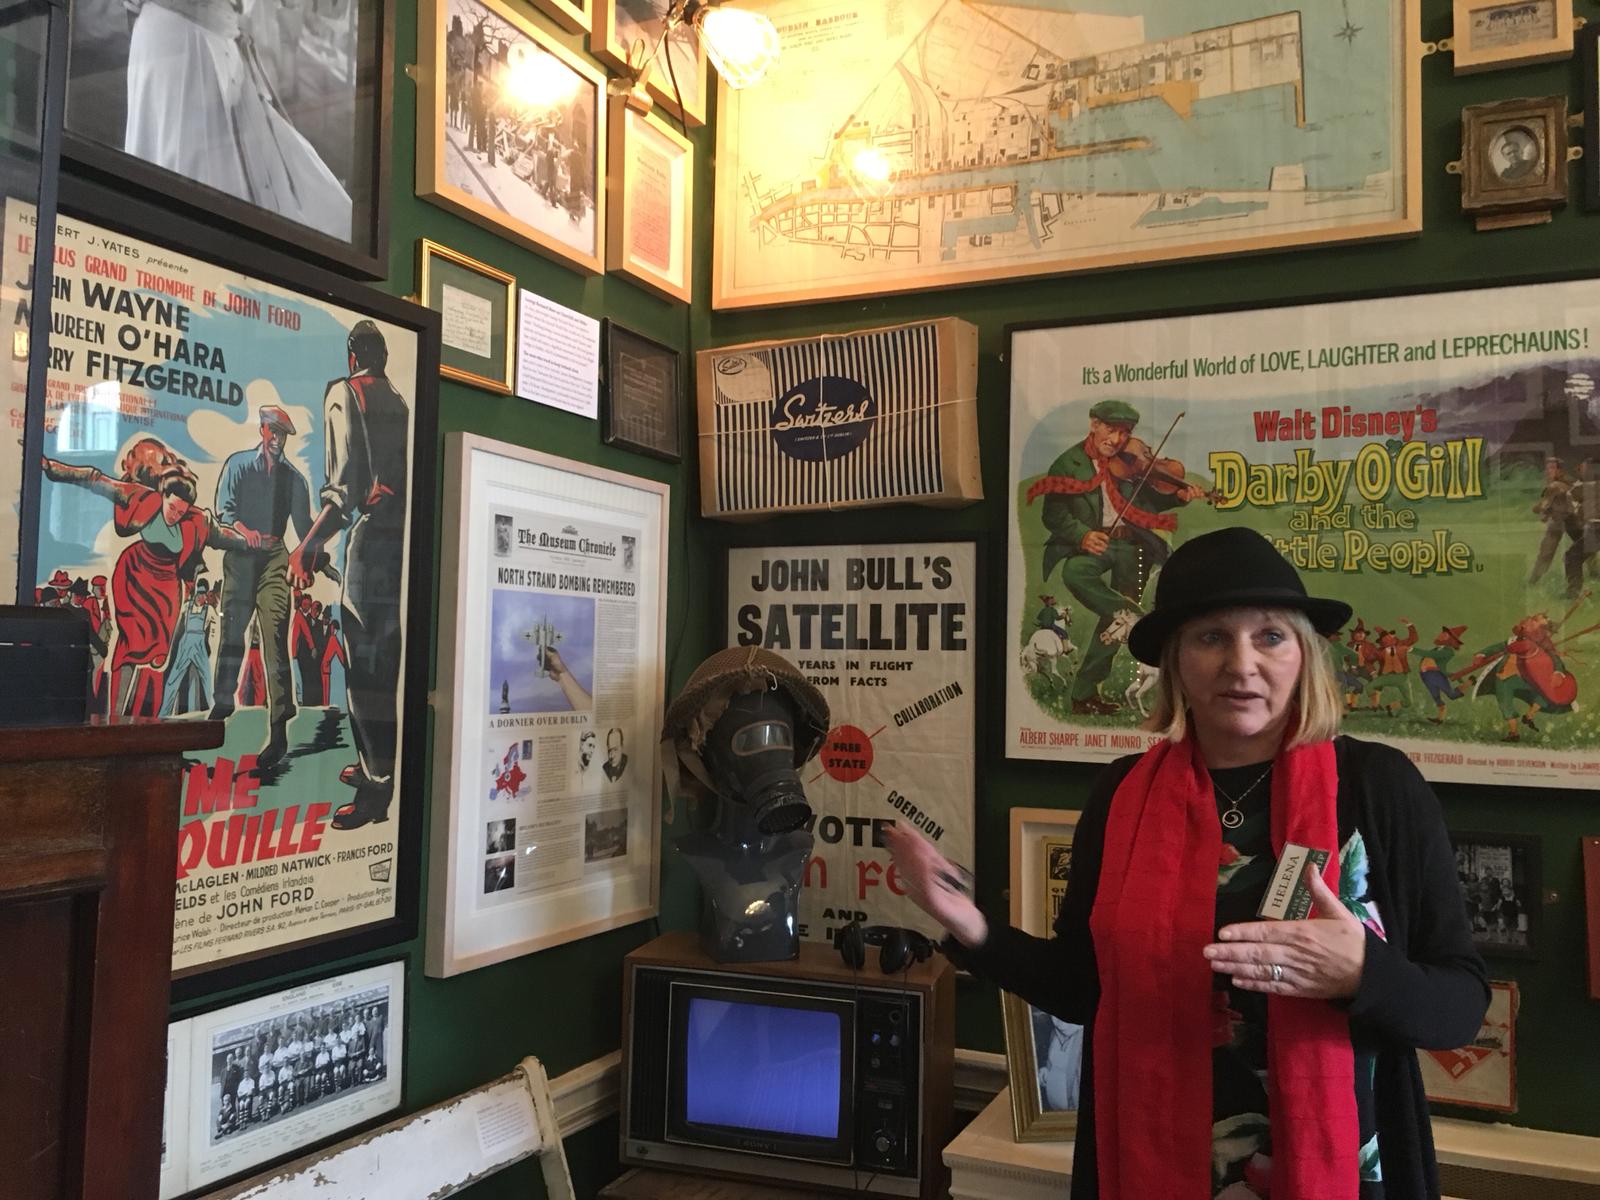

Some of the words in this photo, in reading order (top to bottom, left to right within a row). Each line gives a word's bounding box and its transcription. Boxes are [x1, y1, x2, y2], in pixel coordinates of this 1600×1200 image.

[146, 255, 189, 274] présente
[82, 278, 190, 333] WAYNE
[84, 254, 127, 283] GRAND
[136, 269, 195, 302] TRIOMPHE
[224, 292, 261, 321] JOHN
[268, 304, 302, 331] FORD
[118, 324, 226, 375] O'HARA
[1082, 366, 1100, 386] It's
[1103, 370, 1112, 384] a
[1115, 359, 1188, 384] Wonderful
[1193, 356, 1236, 378] World
[1240, 353, 1256, 374] of
[1260, 350, 1305, 374] LOVE,
[1308, 342, 1399, 369] LAUGHTER
[1404, 339, 1436, 361] and
[1442, 327, 1589, 360] LEPRECHAUNS!
[86, 349, 244, 406] FITZGERALD
[1253, 409, 1316, 442] Walt
[1322, 405, 1438, 442] Disney's
[1208, 447, 1352, 518] Darby
[1289, 503, 1352, 532] and
[1360, 503, 1416, 530] the
[518, 529, 537, 546] The
[538, 532, 578, 551] Museum
[578, 537, 617, 557] Chronicle
[1343, 529, 1470, 577] People
[498, 567, 525, 587] NORTH
[527, 570, 557, 590] STRAND
[559, 574, 591, 593] BOMBING
[592, 577, 636, 598] REMEMBERED
[751, 558, 830, 593] JOHN
[845, 555, 954, 592] BULL'S
[737, 602, 968, 652] SATELLITE
[846, 660, 860, 671] IN
[869, 660, 914, 672] FLIGHT
[850, 676, 888, 687] FACTS
[489, 719, 495, 729] A
[497, 717, 536, 728] DORNIER
[537, 716, 558, 727] OVER
[560, 714, 589, 725] DUBLIN
[893, 681, 964, 728] COLLABORATION
[833, 742, 861, 753] FREE
[1020, 731, 1047, 746] ALBERT
[1049, 732, 1080, 748] SHARPE
[1084, 734, 1108, 748] JANET
[1110, 735, 1141, 750] MUNRO
[1424, 752, 1463, 766] FITZGERALD
[829, 759, 865, 769] STATE
[887, 790, 944, 841] COERCION
[246, 863, 278, 881] MILDRED
[281, 853, 332, 873] NATWICK
[336, 846, 367, 862] FRANCIS
[367, 842, 394, 857] FORD
[210, 891, 220, 904] et
[224, 889, 237, 901] les
[240, 881, 279, 898] Comédiens
[1272, 855, 1300, 908] HELENA
[198, 911, 212, 925] de
[216, 897, 263, 920] JOHN
[270, 886, 314, 909] FORD
[219, 919, 252, 933] Directeur
[262, 910, 294, 925] production
[822, 908, 868, 923] AND
